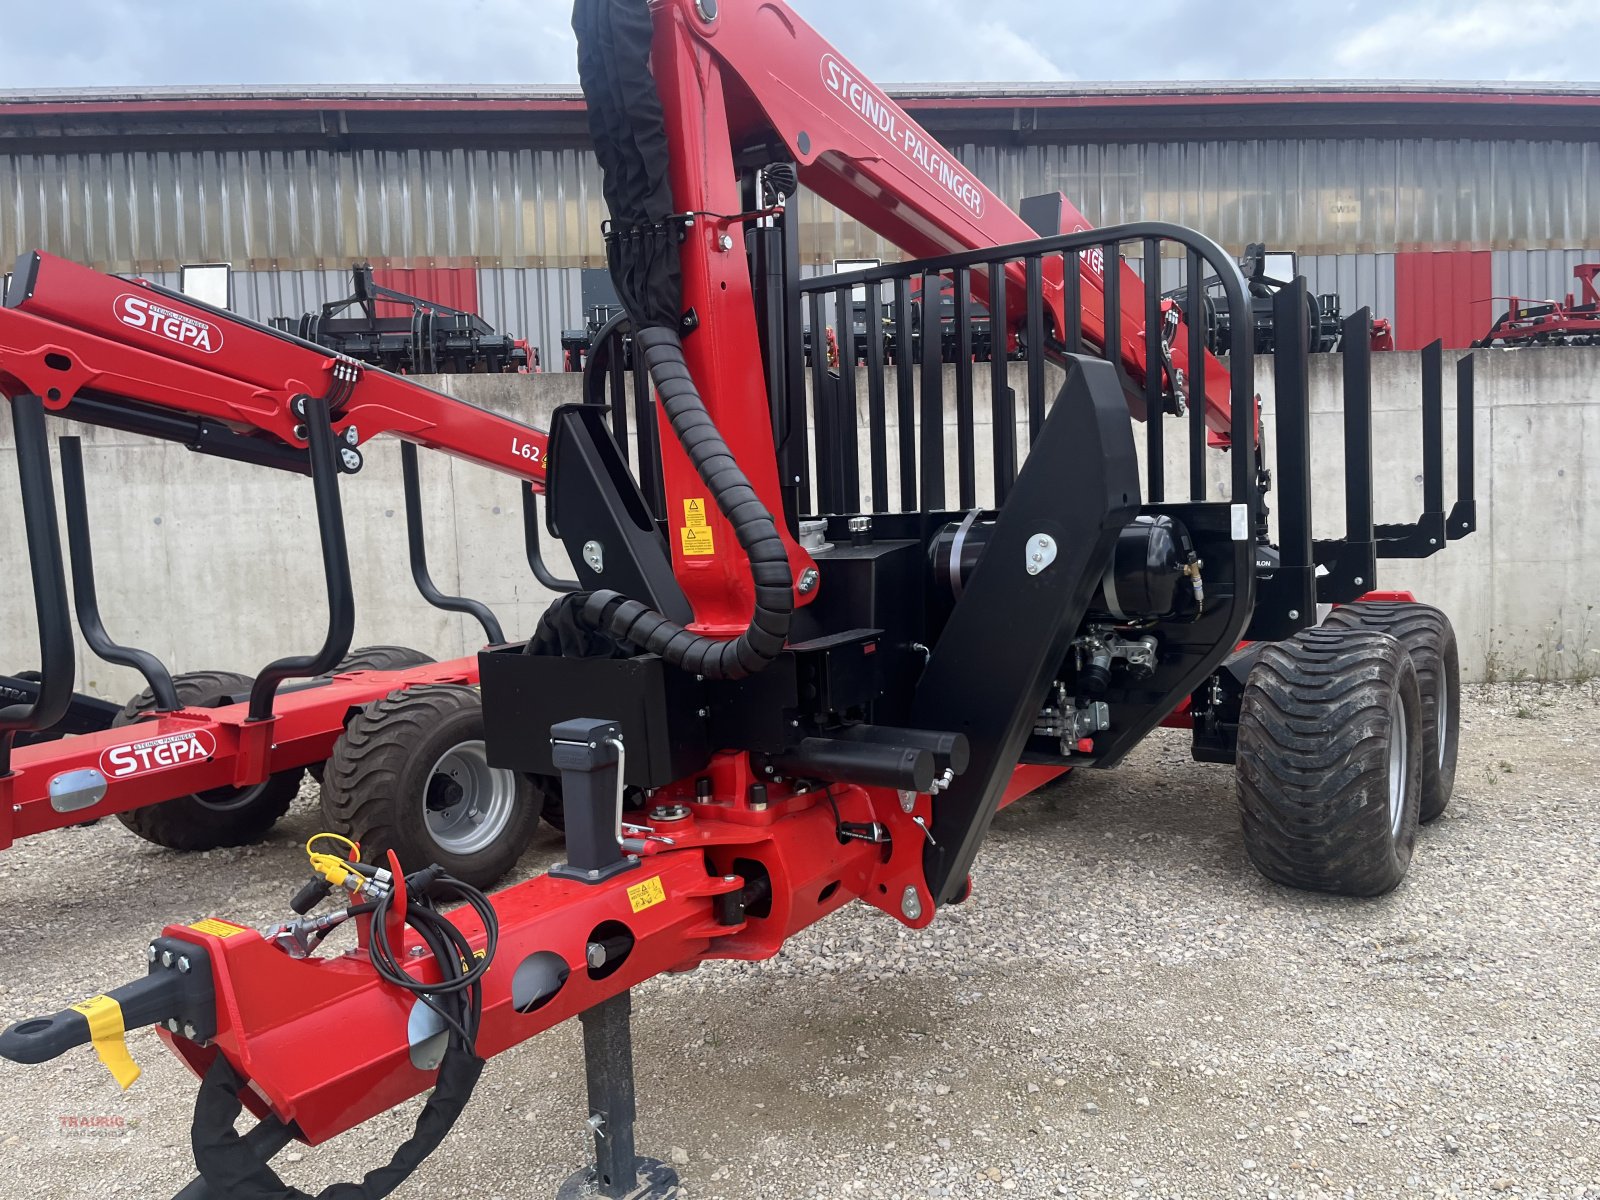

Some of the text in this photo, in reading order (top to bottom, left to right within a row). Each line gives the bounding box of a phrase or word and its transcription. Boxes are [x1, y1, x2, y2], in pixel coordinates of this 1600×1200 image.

[826, 60, 981, 214] STEINDL-PALFINGER
[123, 298, 211, 351] STEPA
[109, 738, 208, 775] STEPA
